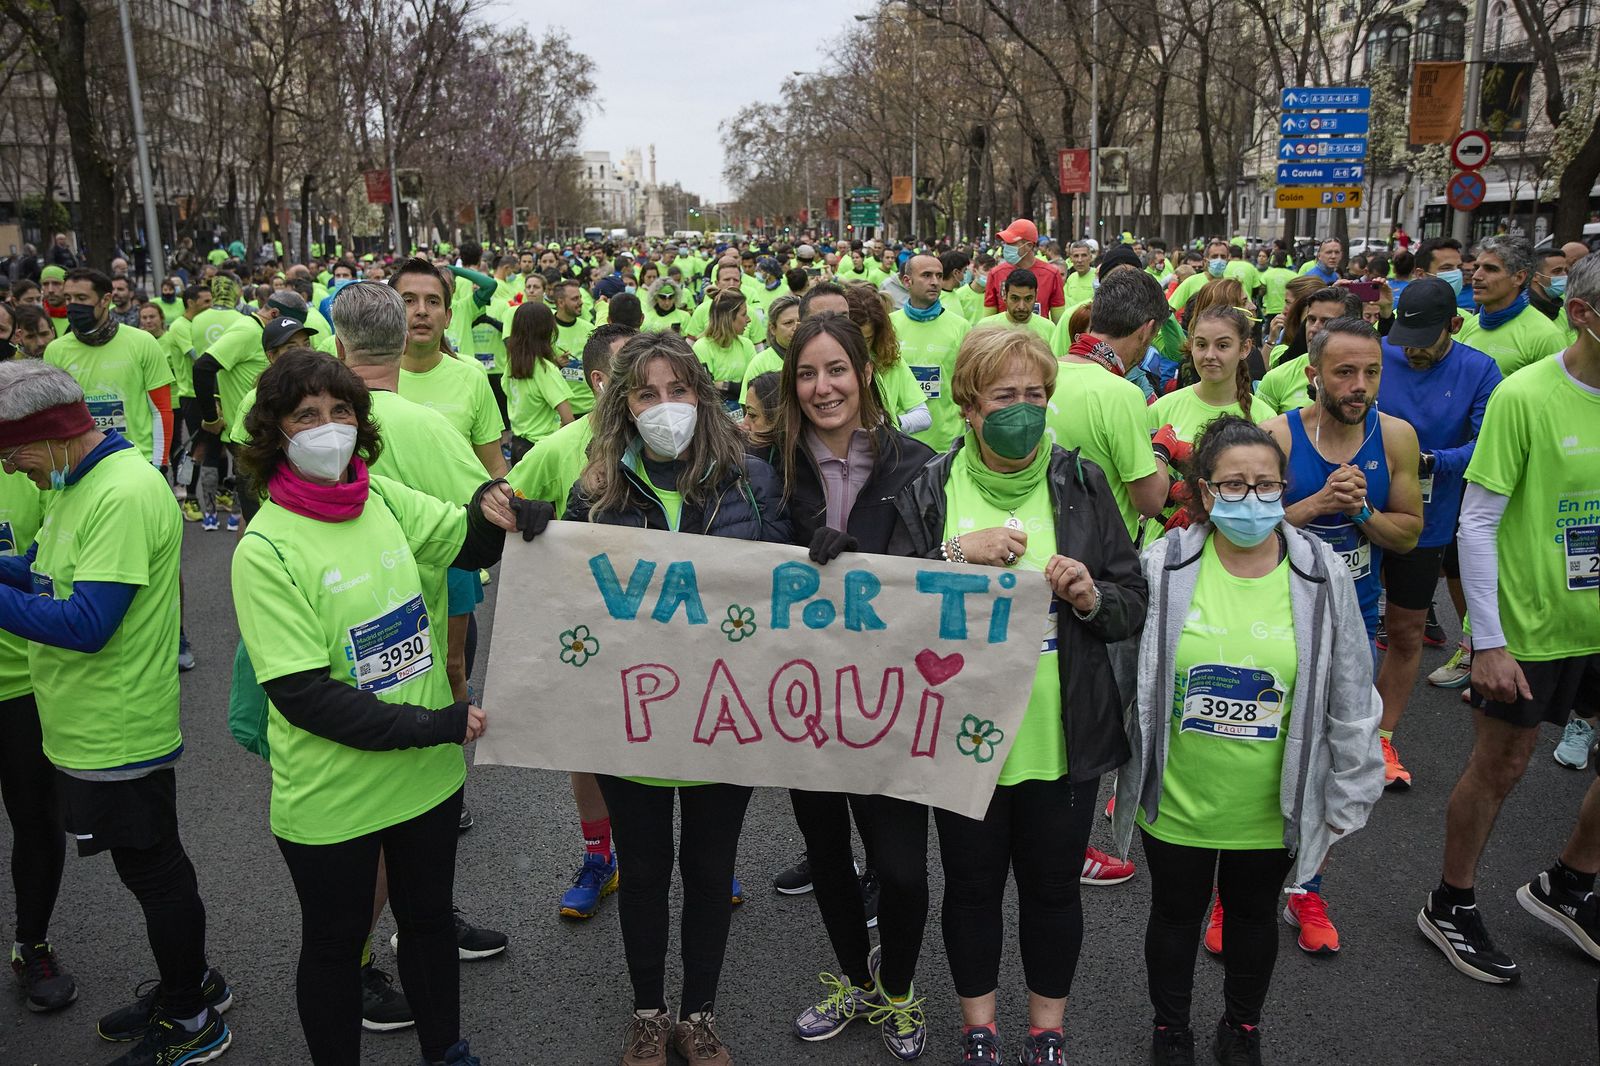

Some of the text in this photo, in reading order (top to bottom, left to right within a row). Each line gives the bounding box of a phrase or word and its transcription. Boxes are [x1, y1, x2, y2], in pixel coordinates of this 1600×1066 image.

[1280, 169, 1288, 178] A
[1291, 168, 1323, 177] Coruña
[1278, 193, 1304, 201] Colón
[1558, 499, 1580, 513] En
[588, 552, 709, 625] VA
[379, 635, 424, 673] 3930
[1200, 697, 1257, 722] 3928
[1217, 724, 1247, 734] PAQUI
